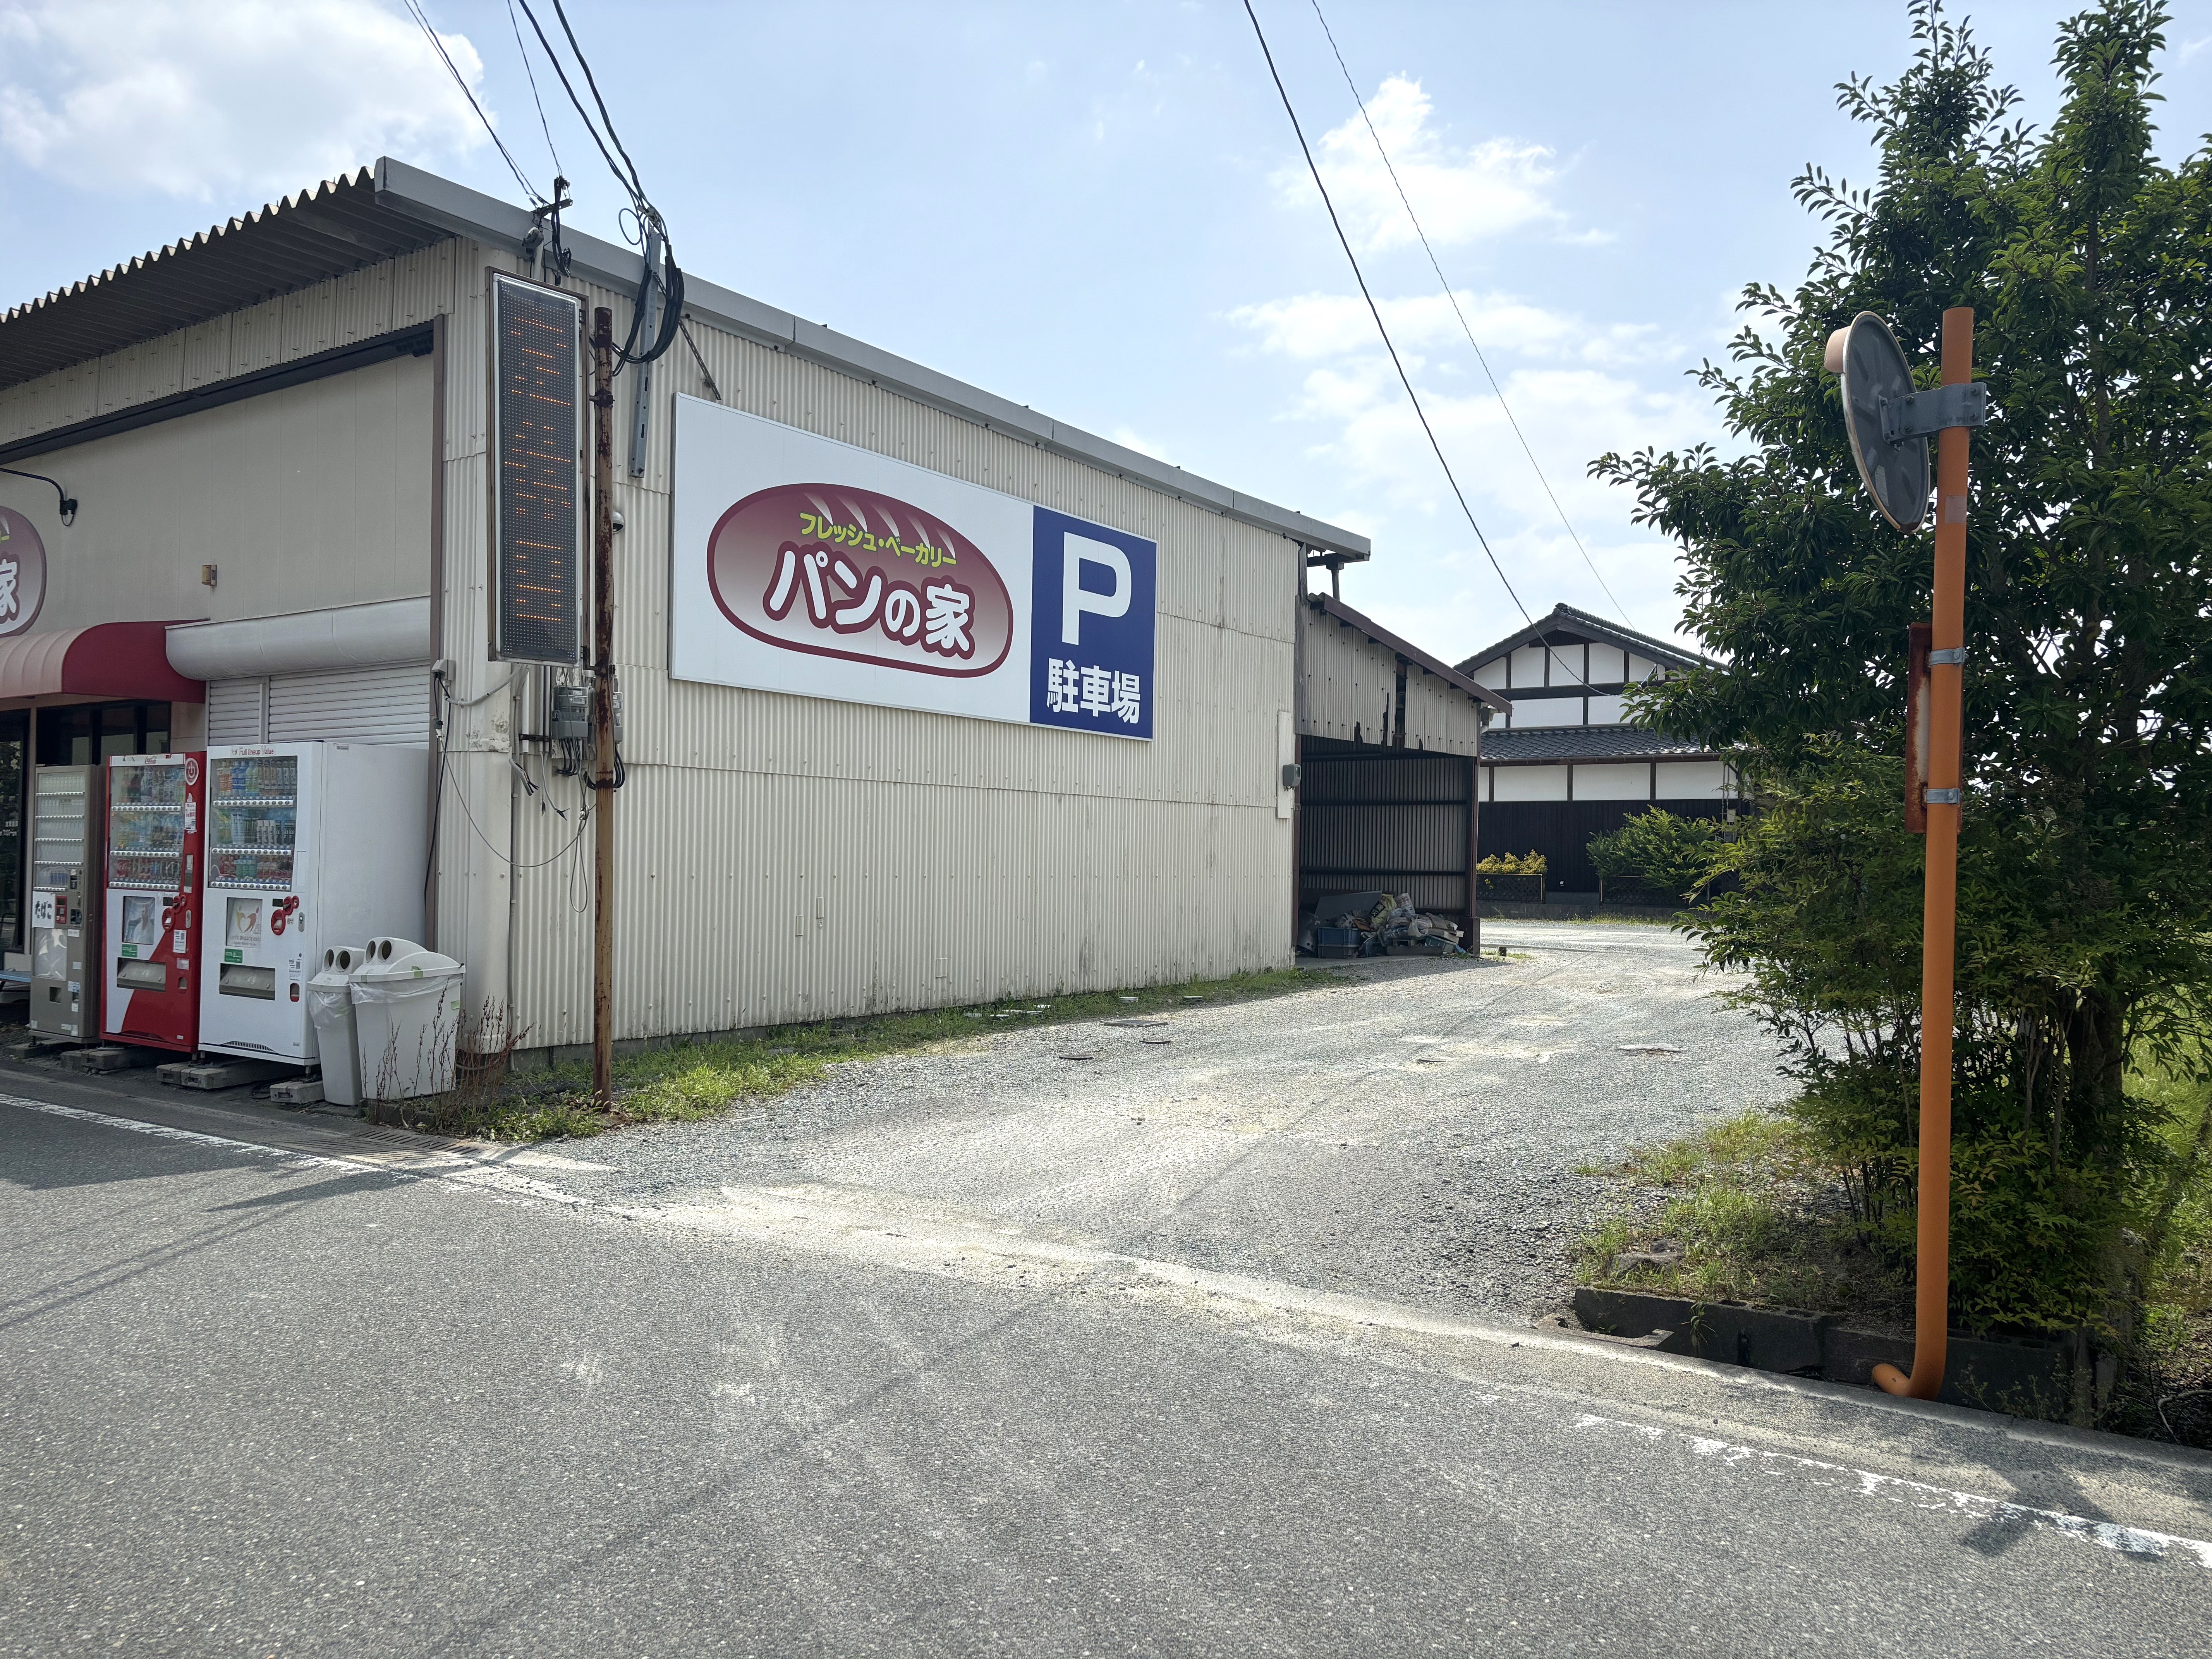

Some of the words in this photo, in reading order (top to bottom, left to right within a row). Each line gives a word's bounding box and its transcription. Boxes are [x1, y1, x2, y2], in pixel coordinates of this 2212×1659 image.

[800, 513, 956, 567] フレッシュ・ベーカリー
[769, 550, 969, 651] パンの家
[1062, 531, 1132, 645] P
[1046, 658, 1140, 724] 駐車場
